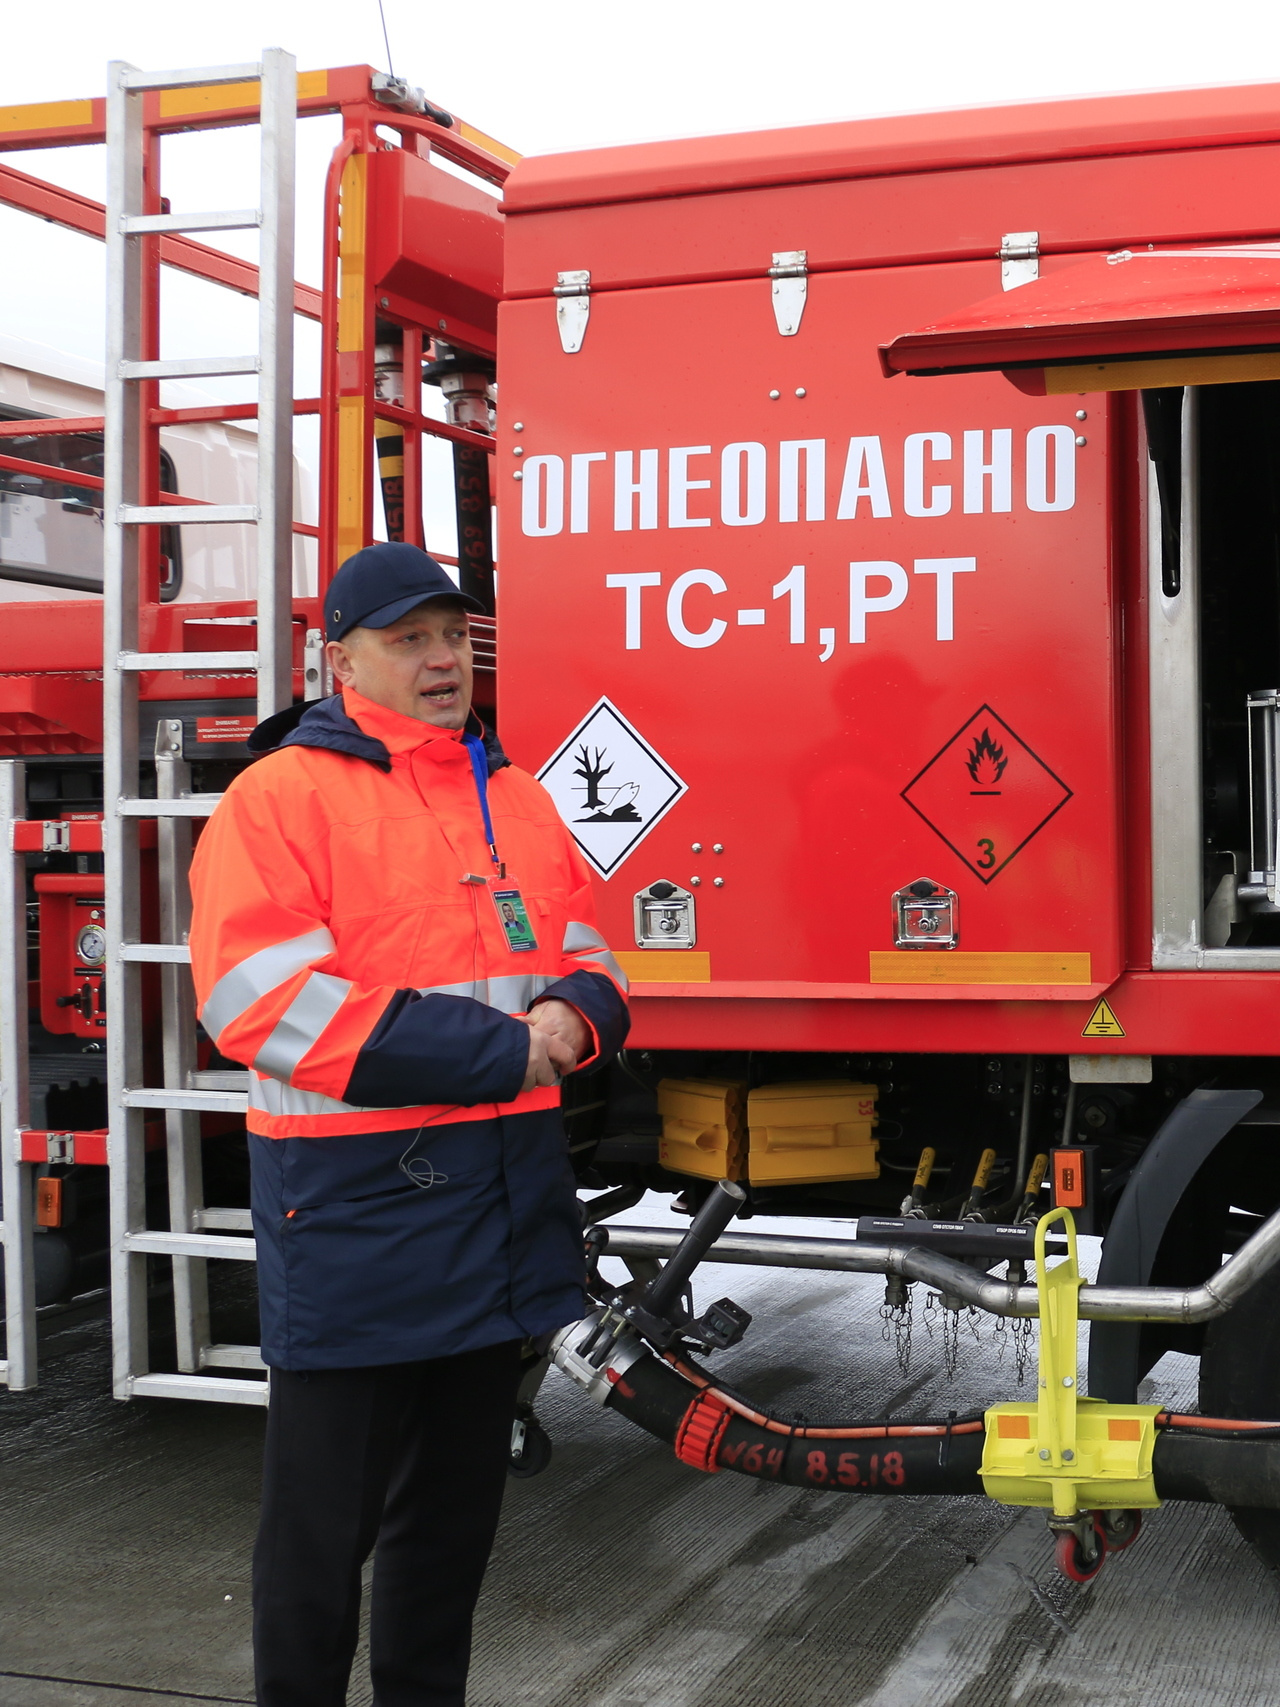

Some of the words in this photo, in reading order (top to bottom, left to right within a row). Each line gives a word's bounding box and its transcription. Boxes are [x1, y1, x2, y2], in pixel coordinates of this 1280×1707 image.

[521, 425, 1076, 537] ОГНЕОПАСНО
[606, 556, 977, 662] ТС-1,РТ
[976, 838, 996, 869] 3
[858, 1099, 874, 1117] 53
[805, 1449, 907, 1487] 8.5.18
